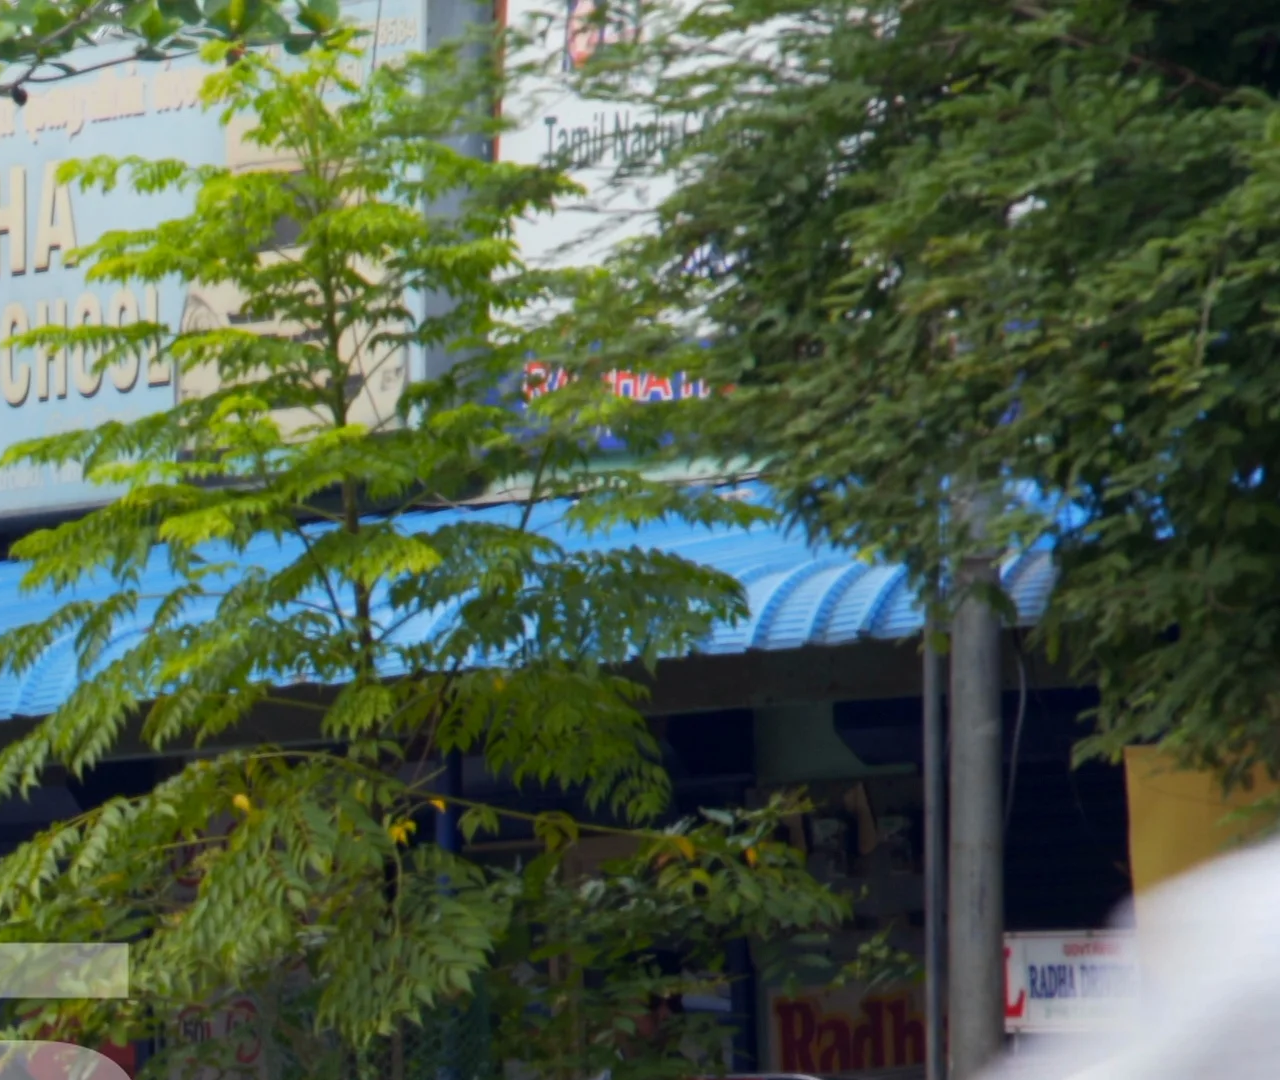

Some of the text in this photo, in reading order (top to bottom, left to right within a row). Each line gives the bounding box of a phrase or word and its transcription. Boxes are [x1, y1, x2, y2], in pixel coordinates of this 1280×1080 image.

[544, 111, 607, 170] Tamil
[1028, 963, 1076, 999] RADHA
[773, 994, 950, 1072] Radh
